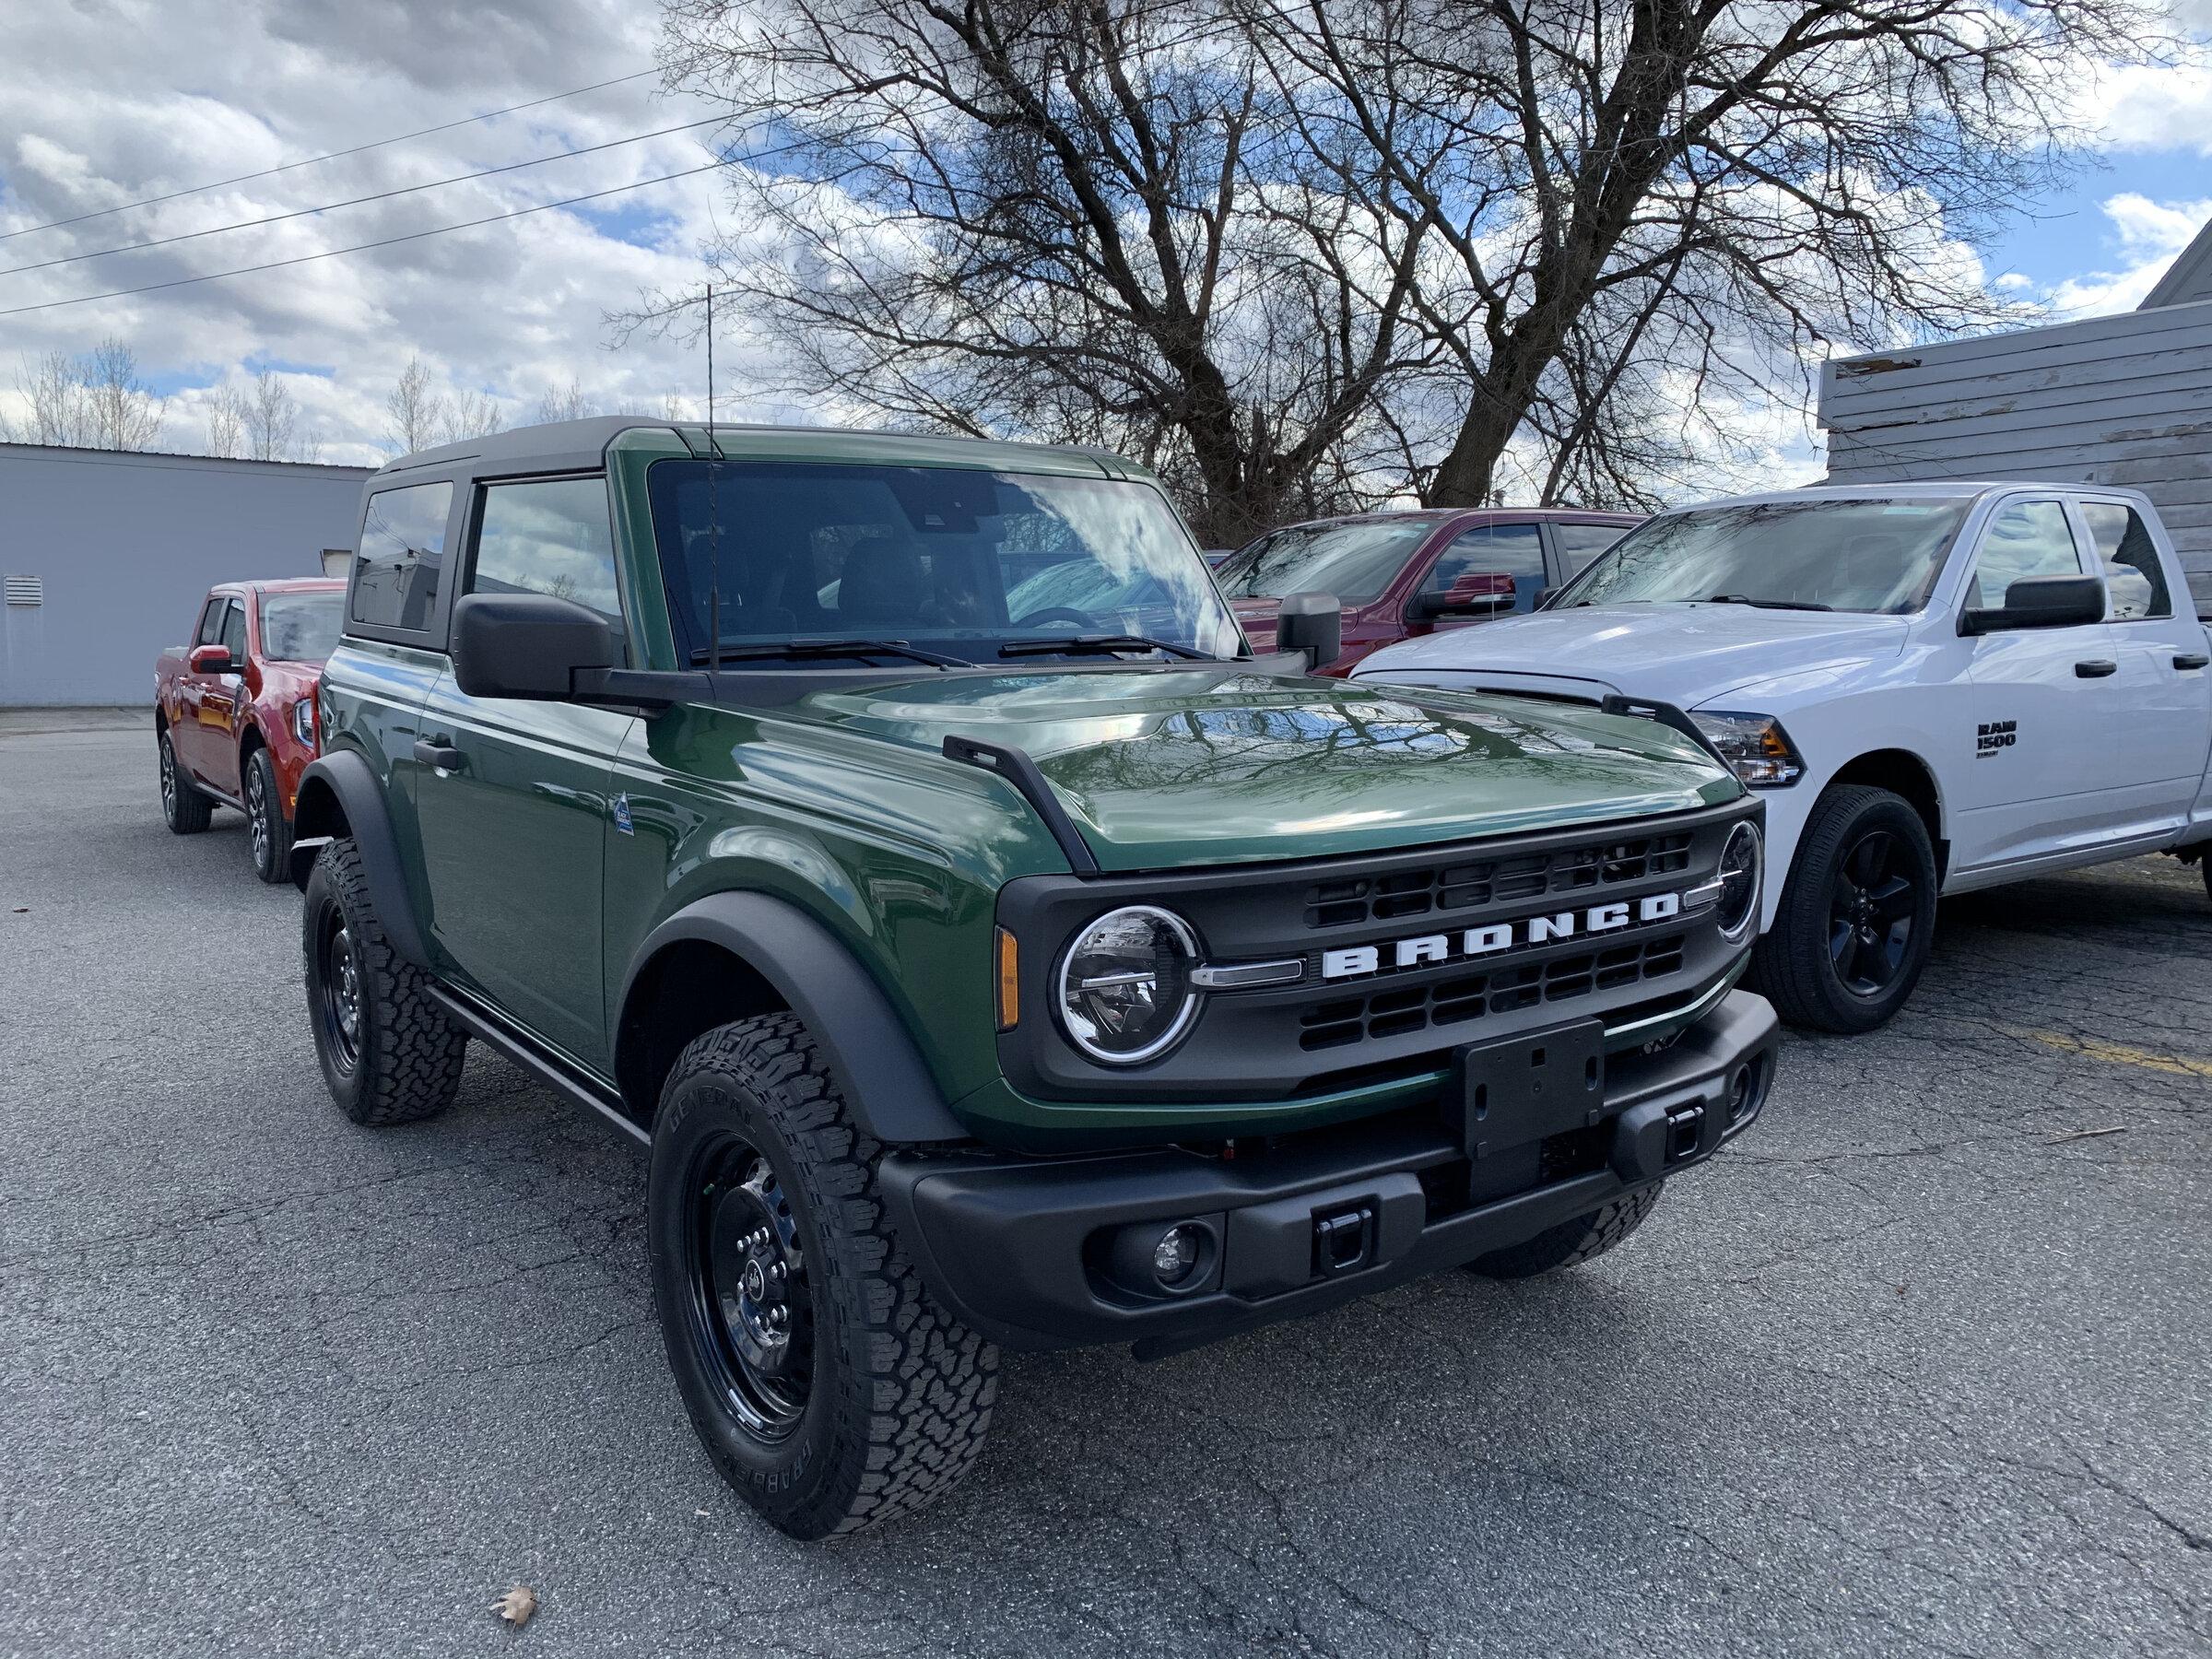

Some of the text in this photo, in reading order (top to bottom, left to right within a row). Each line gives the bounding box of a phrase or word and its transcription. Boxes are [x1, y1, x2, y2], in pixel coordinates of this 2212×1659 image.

[1978, 720, 2017, 736] RAM
[1977, 733, 2017, 750] 1500
[1322, 892, 1679, 979] BRONCO
